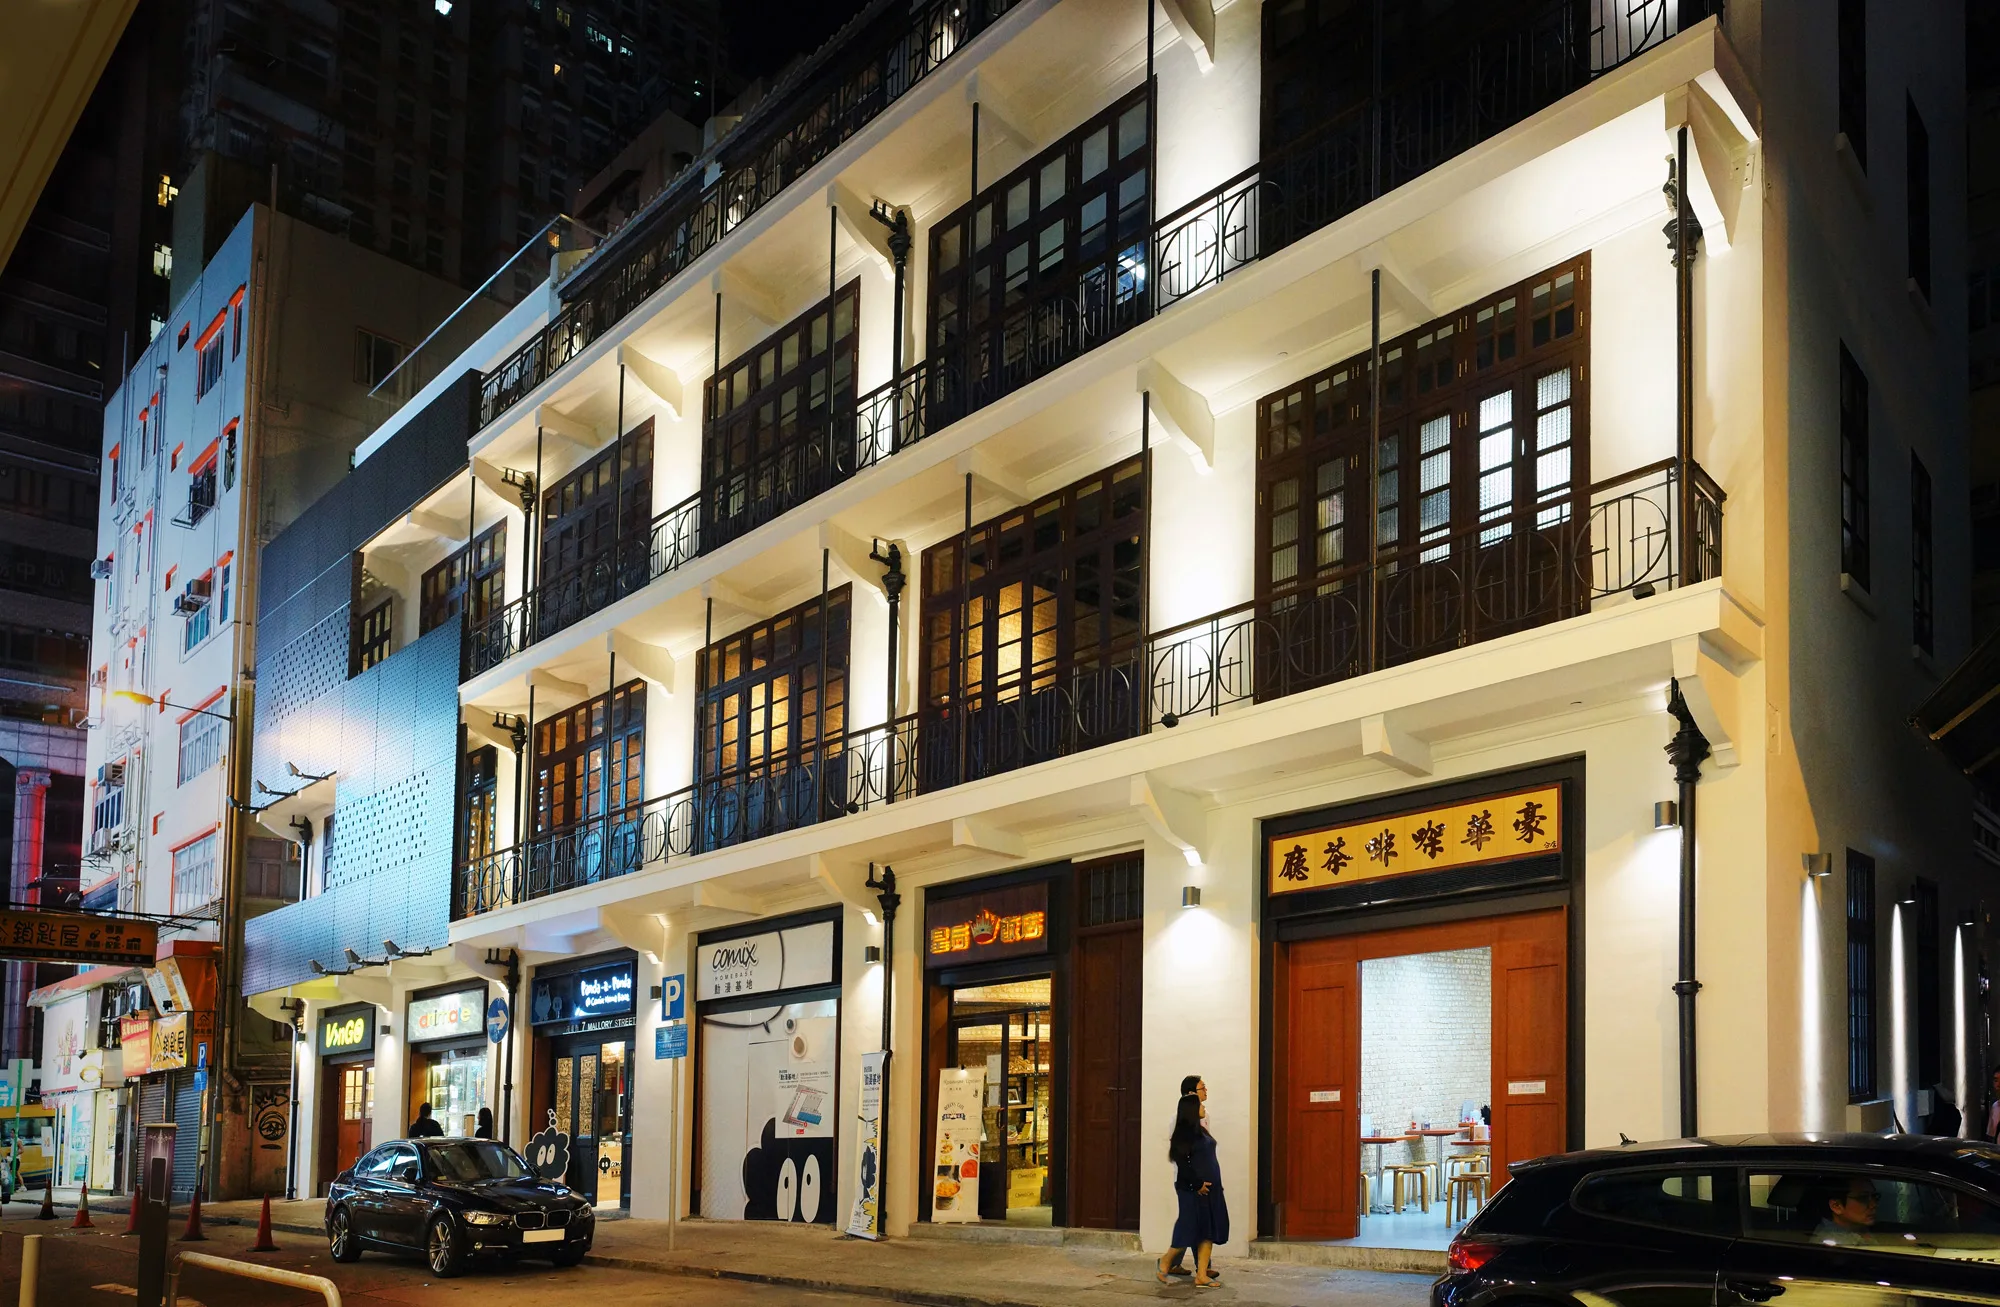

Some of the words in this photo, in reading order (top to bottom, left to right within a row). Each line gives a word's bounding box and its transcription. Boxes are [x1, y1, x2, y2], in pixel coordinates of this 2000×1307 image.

[13, 920, 80, 948] 鎖匙屋
[713, 941, 757, 969] comix
[665, 980, 680, 1017] P
[714, 979, 753, 994] 動漫基地
[581, 1021, 586, 1031] 7
[587, 1020, 613, 1030] MALLORY
[614, 1017, 637, 1027] STREET
[198, 1046, 206, 1067] P
